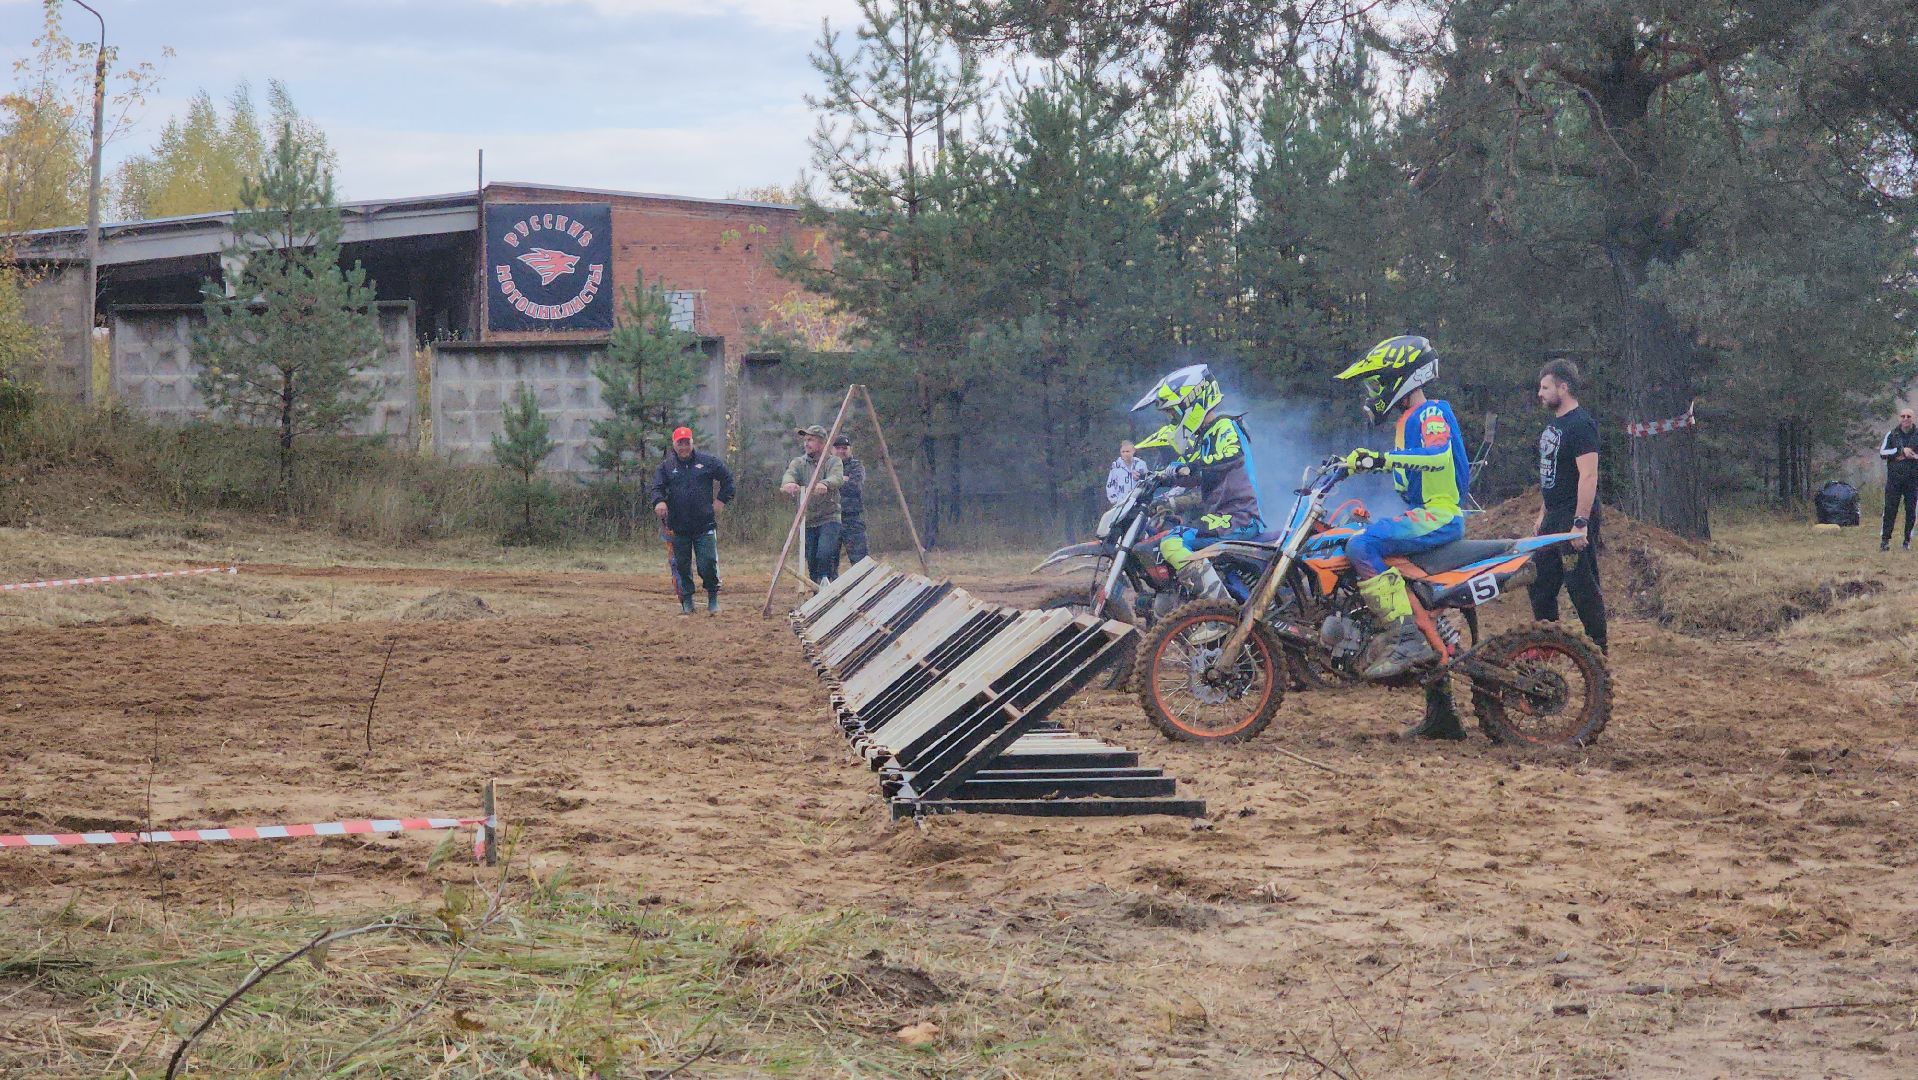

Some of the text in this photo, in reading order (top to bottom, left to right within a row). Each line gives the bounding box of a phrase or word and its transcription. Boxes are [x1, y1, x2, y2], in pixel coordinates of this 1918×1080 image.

[504, 214, 593, 247] РУССКИЕ
[496, 264, 603, 319] МОТОЦИКЛИСТЫ
[1473, 576, 1496, 600] 5
